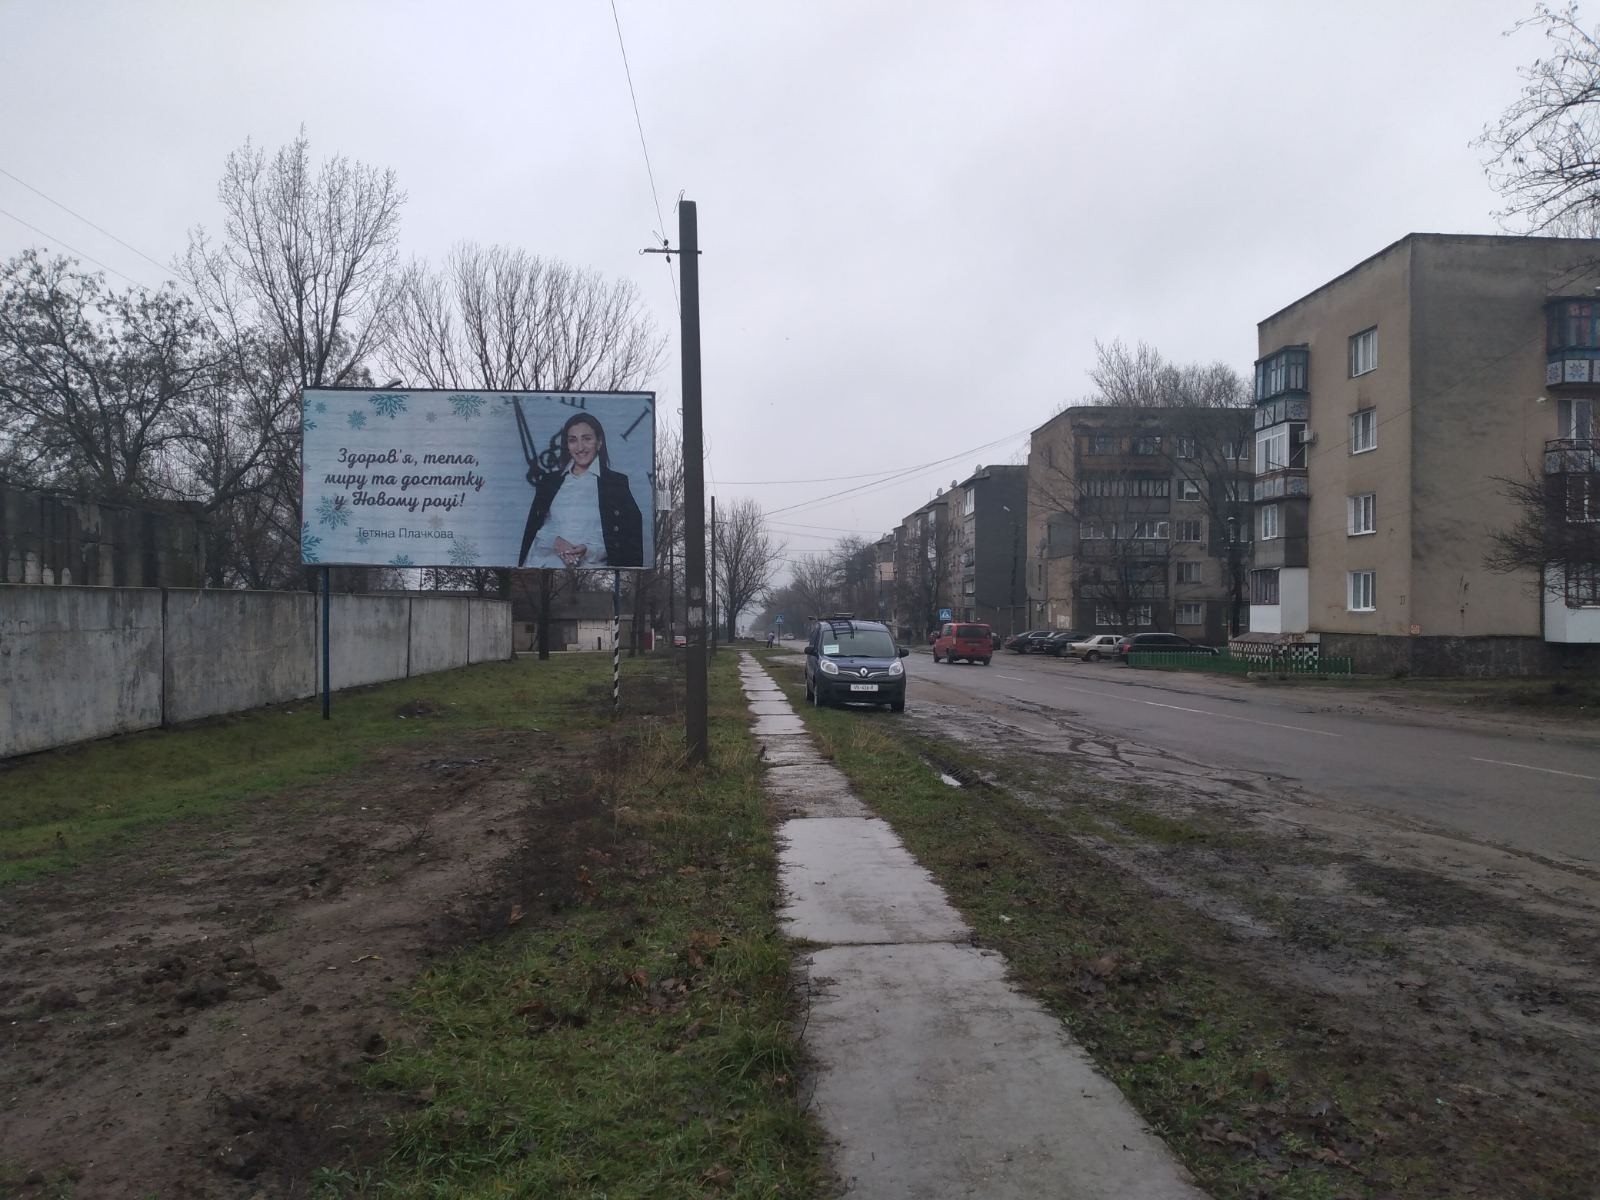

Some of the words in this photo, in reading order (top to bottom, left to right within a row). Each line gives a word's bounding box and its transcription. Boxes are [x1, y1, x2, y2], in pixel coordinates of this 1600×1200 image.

[337, 447, 418, 468] Здоров'я,
[423, 454, 479, 466] тепла,
[324, 473, 367, 490] миру
[371, 473, 398, 486] та
[400, 470, 486, 491] достатку
[334, 494, 346, 511] у
[351, 491, 420, 512] Новому
[422, 493, 466, 512] році!
[357, 527, 395, 540] Тетяна
[399, 527, 454, 540] Плачкова
